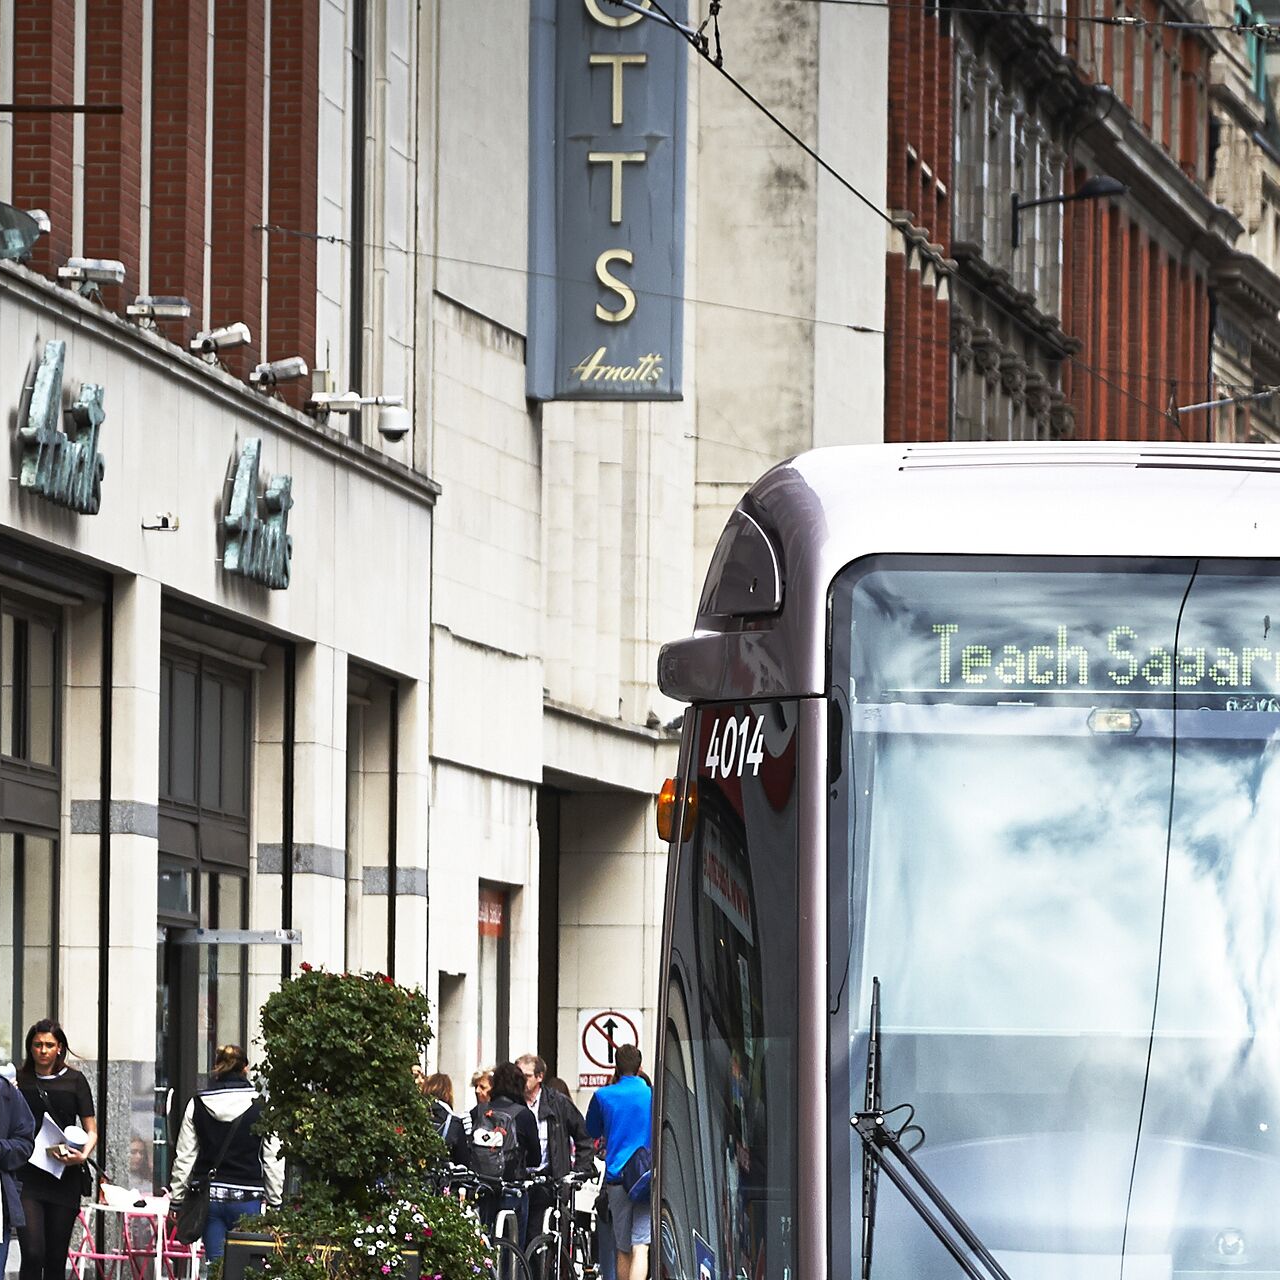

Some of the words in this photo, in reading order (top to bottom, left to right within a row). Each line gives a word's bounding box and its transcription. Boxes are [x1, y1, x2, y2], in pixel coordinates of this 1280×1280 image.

[571, 347, 664, 384] Arnotts
[932, 624, 1088, 685] Teach
[705, 715, 765, 779] 4014
[580, 1076, 588, 1085] NO
[589, 1076, 607, 1085] ENTRY
